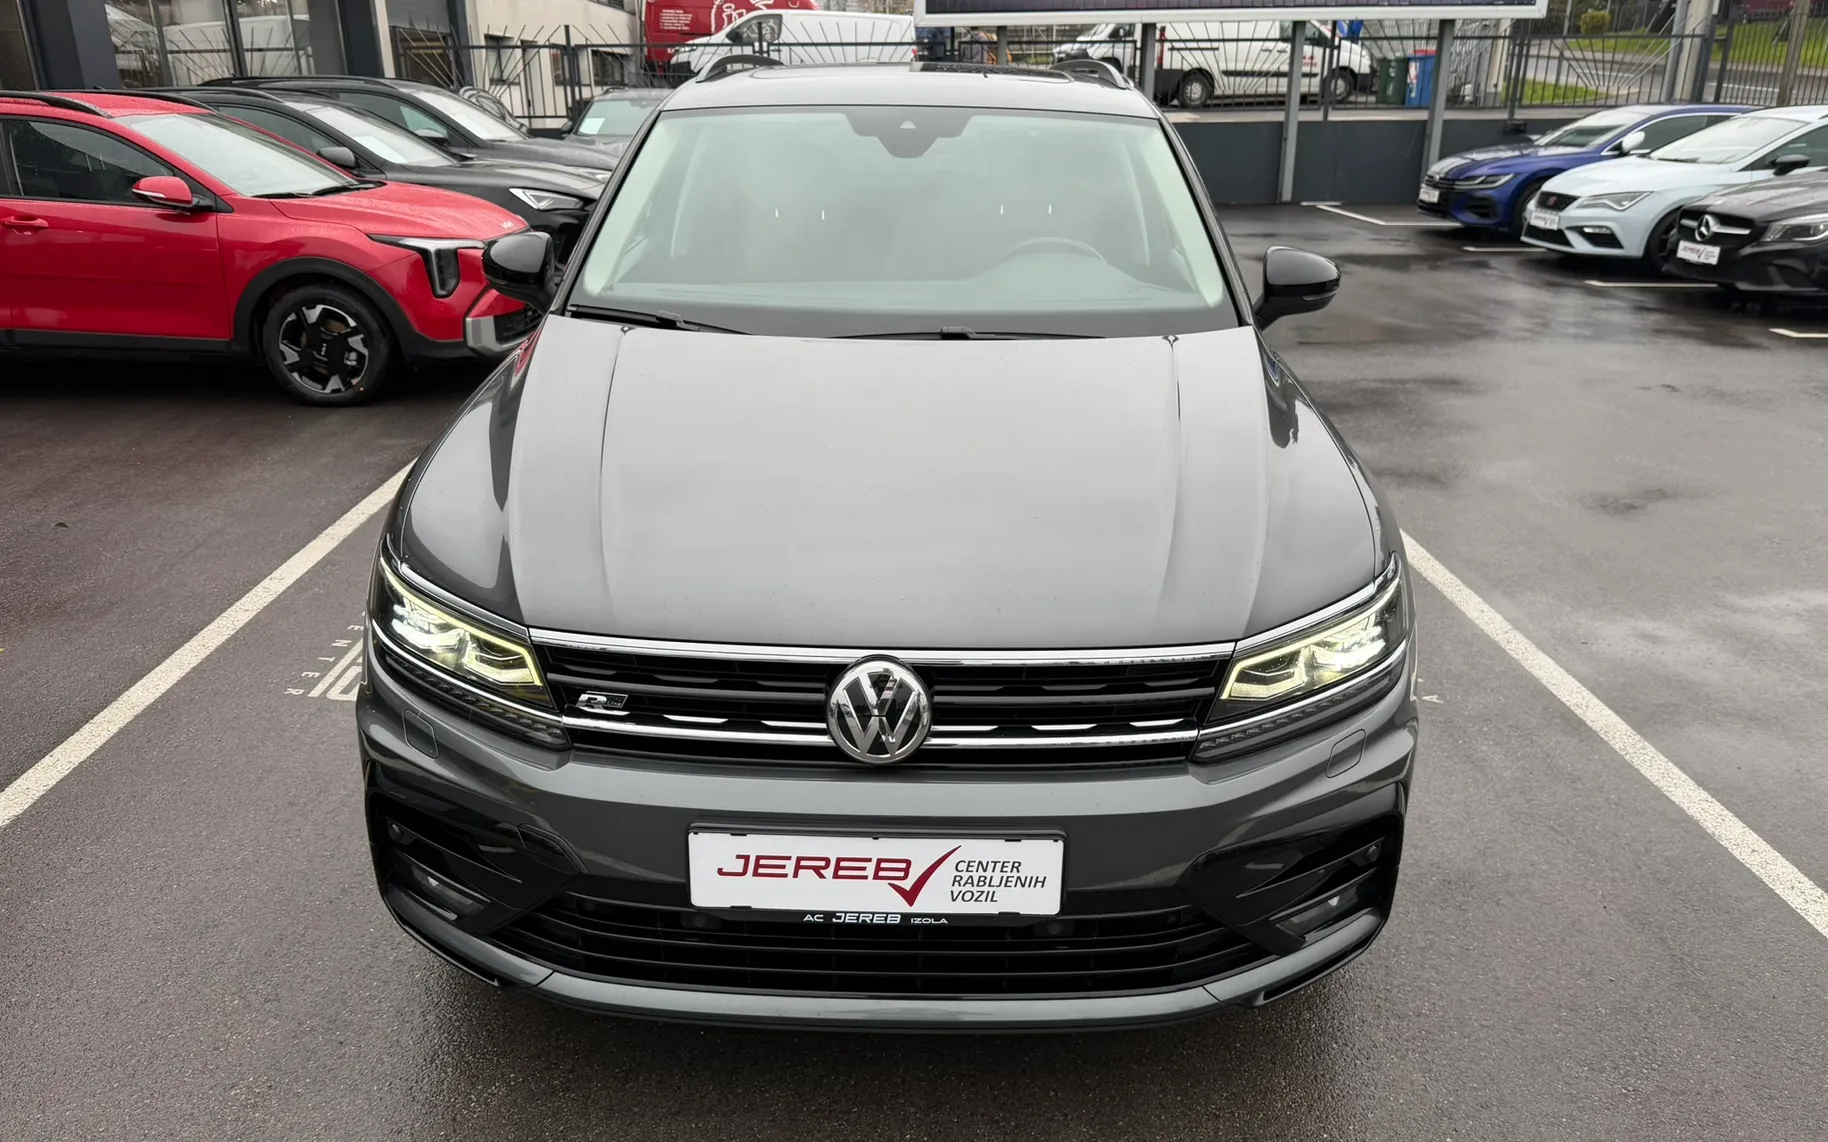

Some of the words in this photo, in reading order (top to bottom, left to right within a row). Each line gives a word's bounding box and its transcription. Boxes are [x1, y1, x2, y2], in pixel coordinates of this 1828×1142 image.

[283, 610, 366, 696] ENTER
[717, 854, 912, 881] JEREB
[954, 860, 1022, 873] CENTER
[951, 875, 1047, 888] RABLJENIH
[950, 890, 998, 903] VOZIL
[803, 914, 824, 922] AC
[832, 913, 901, 924] JEREB
